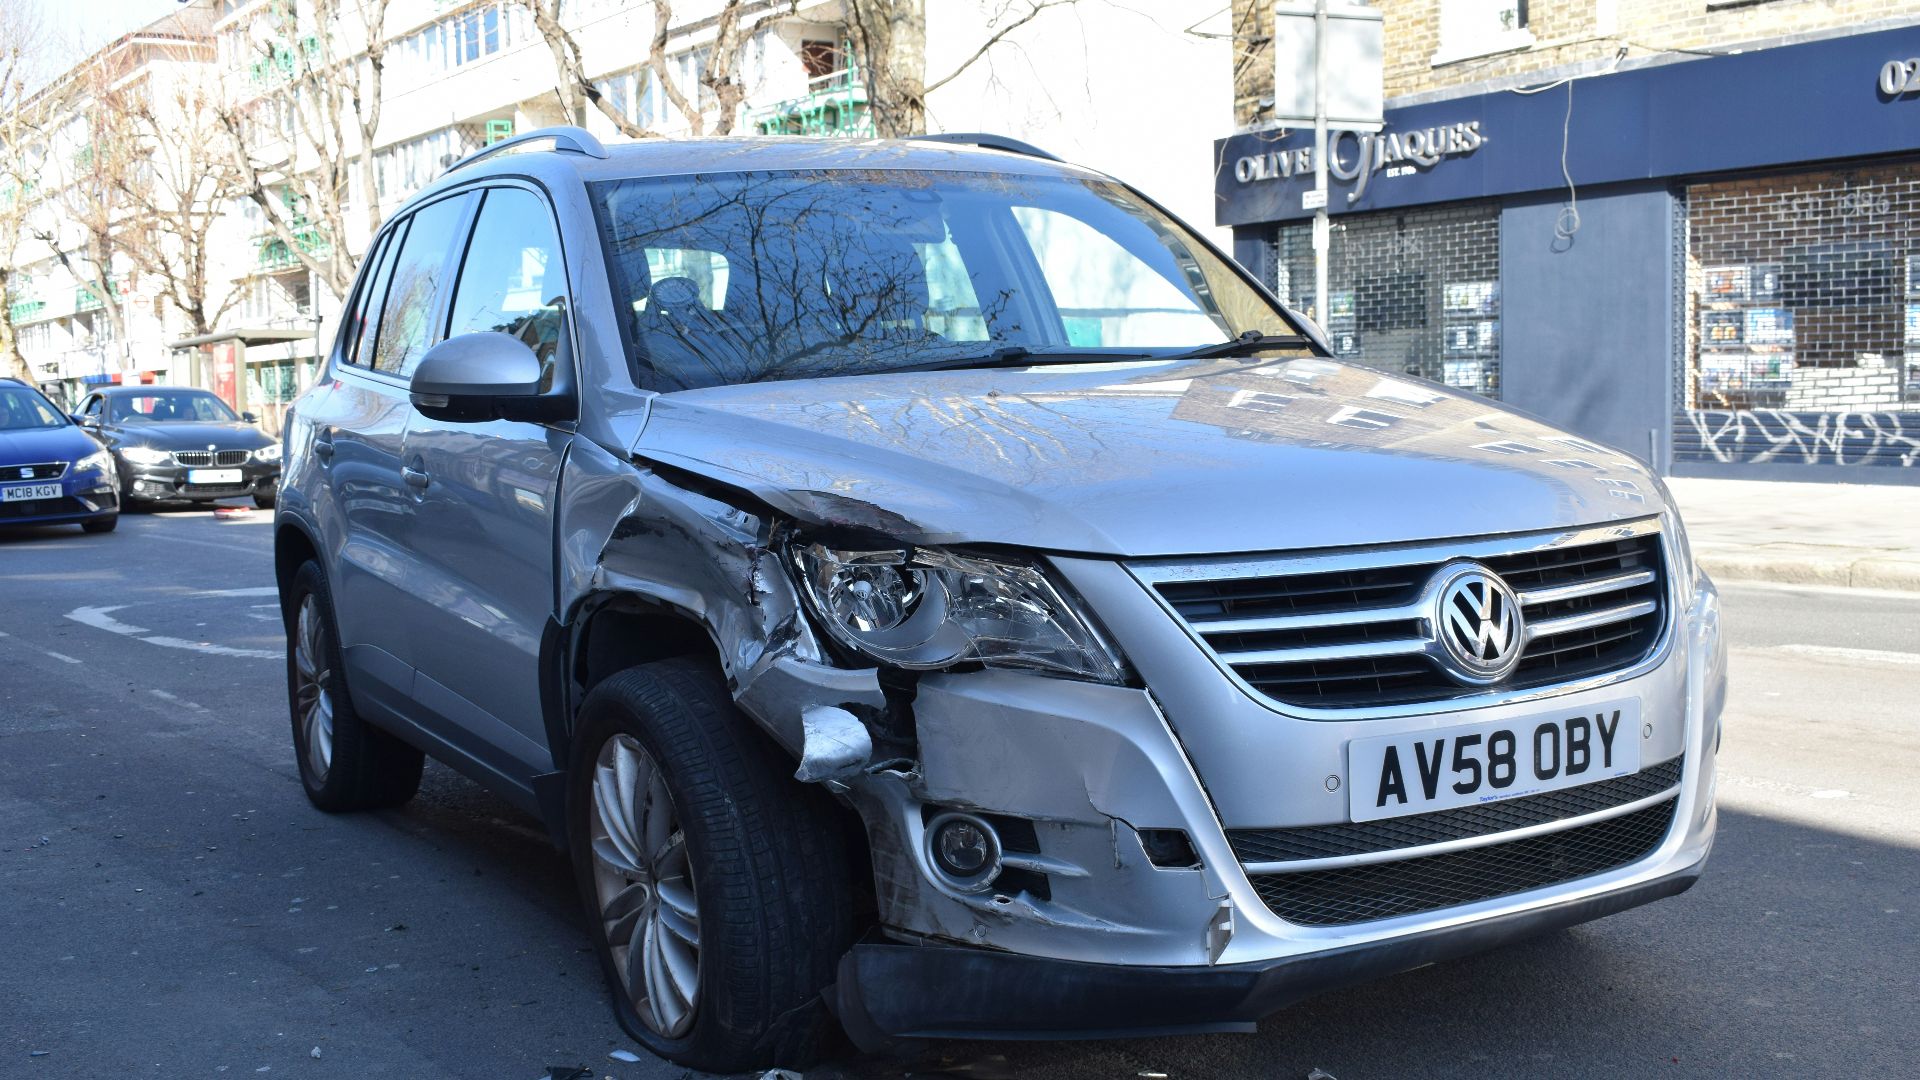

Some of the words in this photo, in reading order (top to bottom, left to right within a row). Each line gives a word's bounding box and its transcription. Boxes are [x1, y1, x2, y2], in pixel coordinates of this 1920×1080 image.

[1235, 146, 1317, 183] OLIVE
[1373, 121, 1481, 170] JAQUES
[7, 487, 33, 499] MC18
[36, 485, 57, 497] KGV
[1376, 729, 1517, 807] AV58
[1533, 709, 1621, 781] OBY
